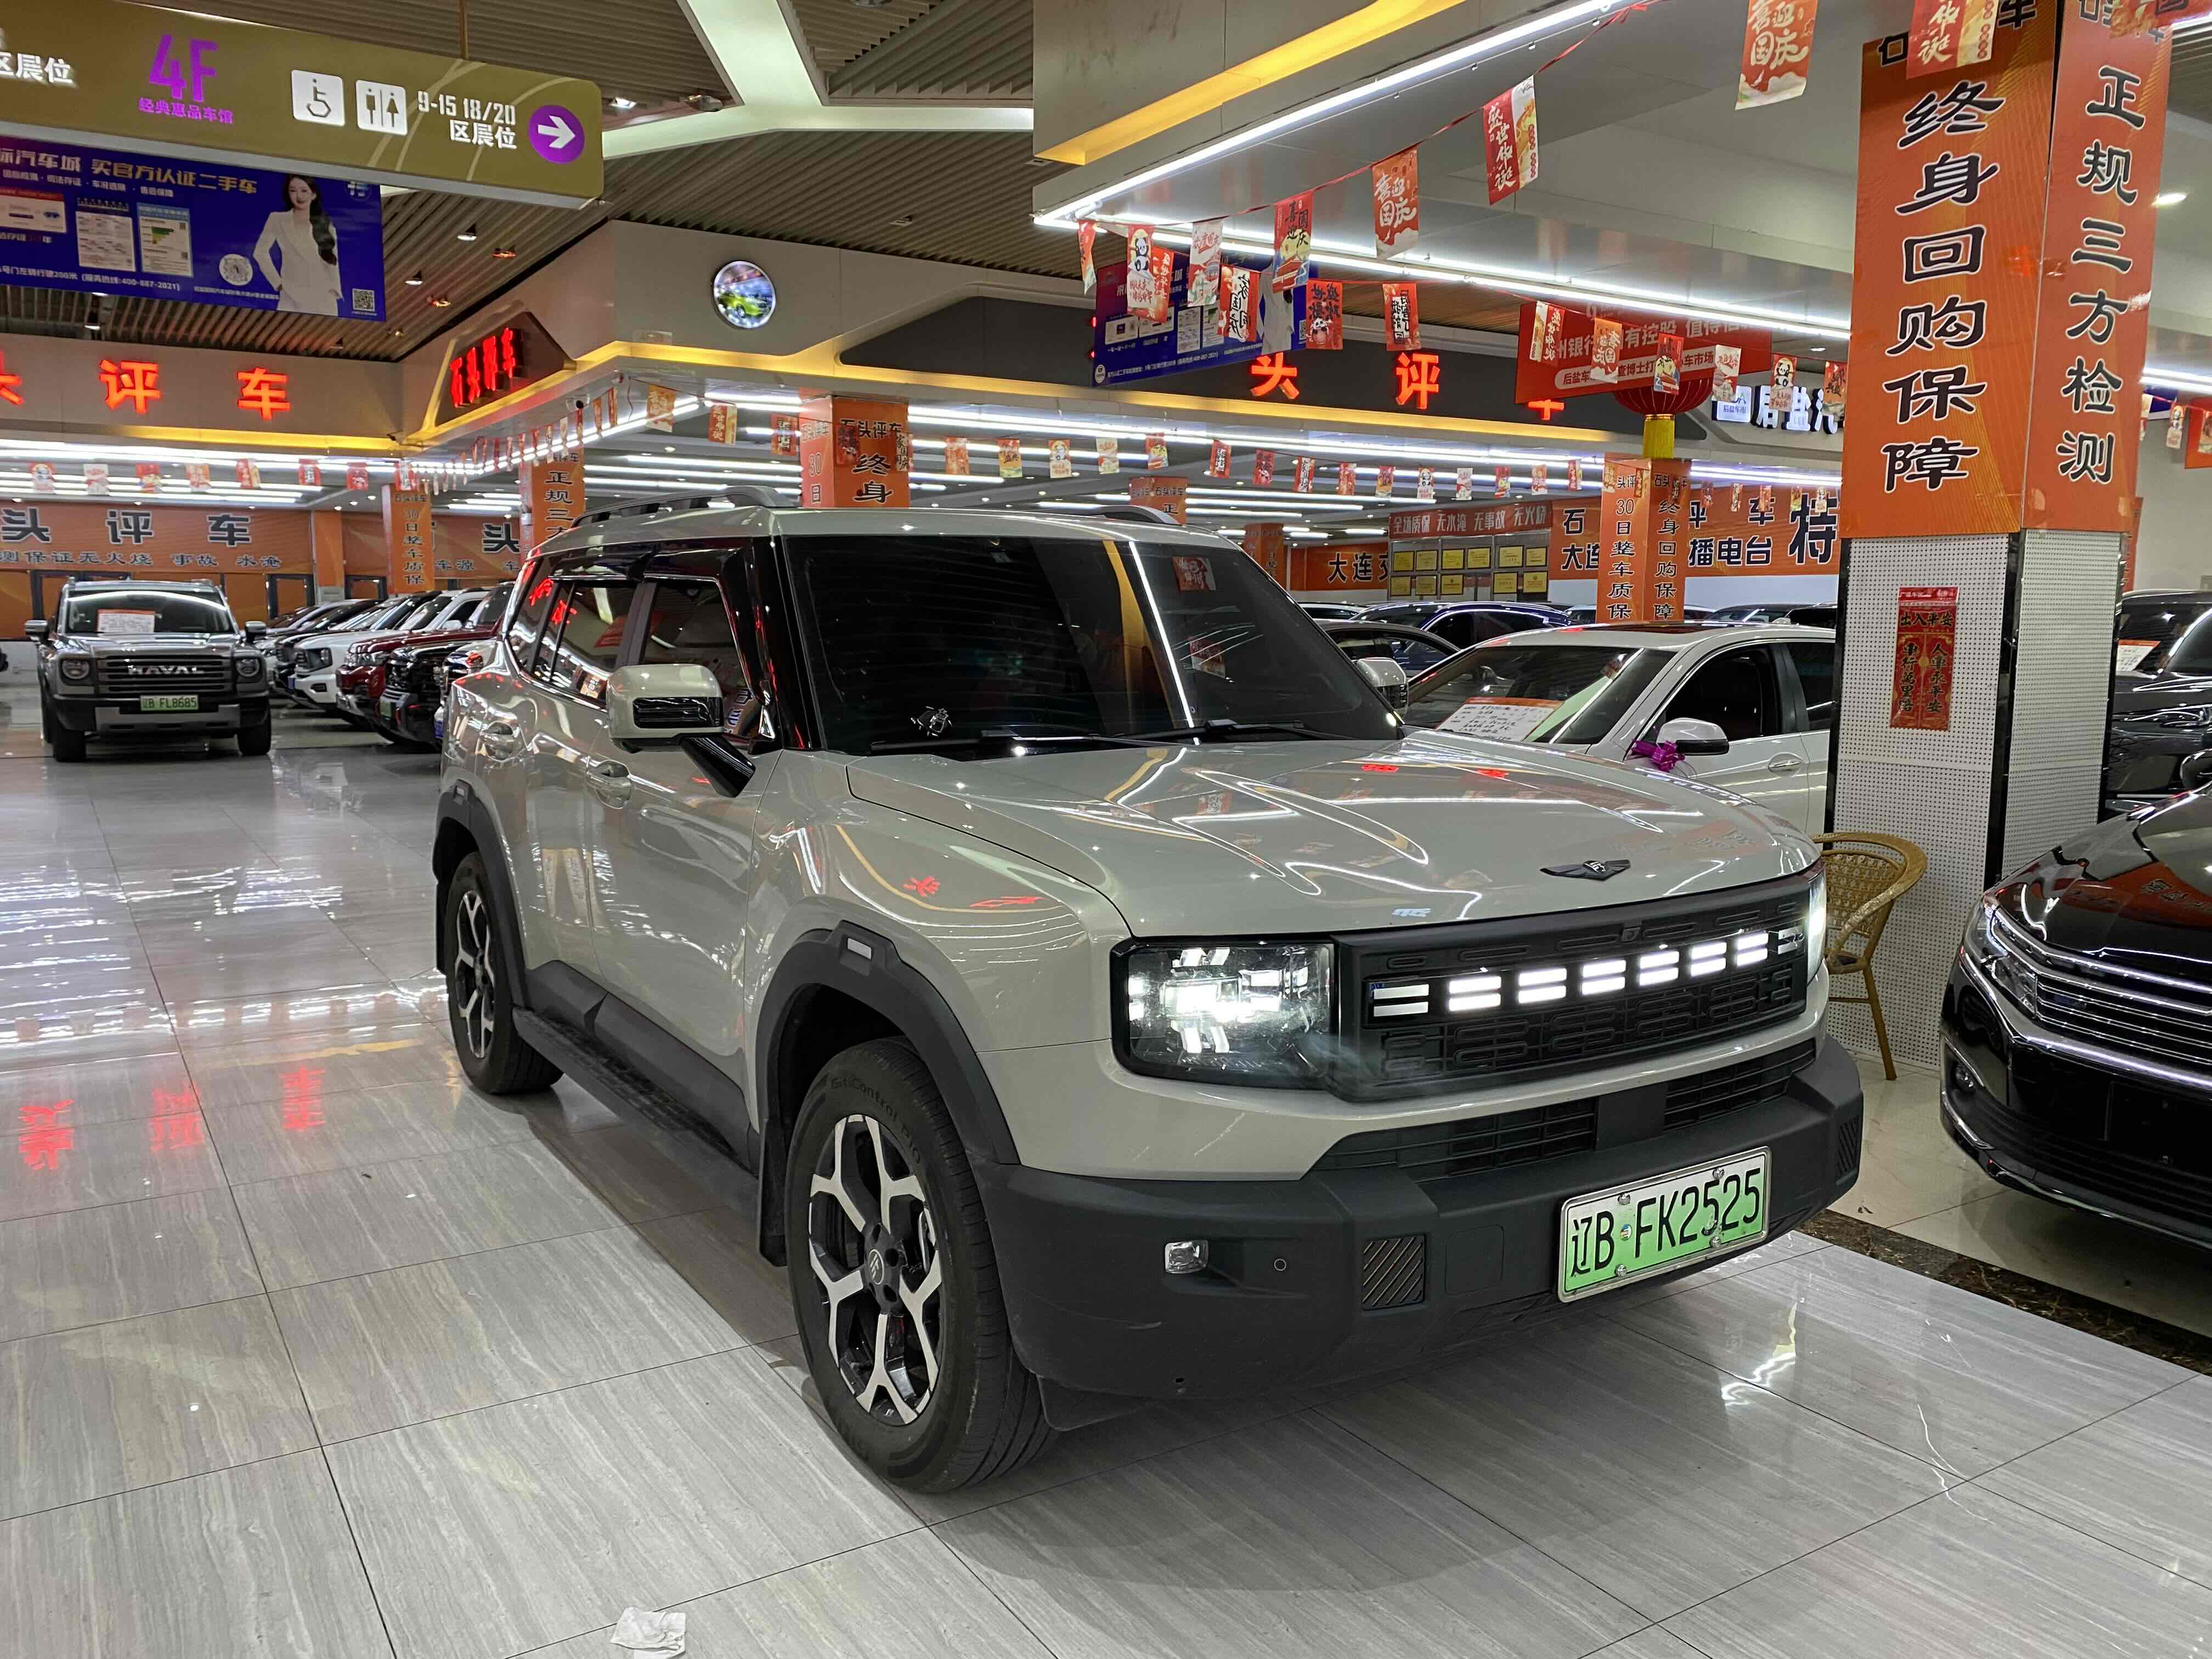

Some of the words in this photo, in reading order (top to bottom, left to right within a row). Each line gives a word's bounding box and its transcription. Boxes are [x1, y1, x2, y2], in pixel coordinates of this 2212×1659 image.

[149, 34, 218, 101] 4F
[417, 91, 457, 117] 9-15
[463, 98, 516, 126] 18/20
[449, 119, 518, 149] 区展位
[1379, 196, 1417, 228] 国庆
[1881, 80, 2006, 493] 终身回购保障
[2056, 65, 2145, 484] 正规三方检测
[851, 453, 894, 504] 终身
[482, 522, 521, 554] 头
[1393, 514, 1431, 534] 全场质保
[1436, 513, 1466, 532] 无水淹
[1474, 509, 1505, 531] 无事故
[1514, 504, 1547, 527] 无火烧
[1788, 493, 1838, 565] 特
[171, 552, 218, 566] 事故
[236, 554, 282, 567] 水淹
[1607, 499, 1636, 620] 30日整车质保
[1654, 500, 1681, 619] 终身回购保障
[1899, 611, 1954, 627] 出入平安
[127, 664, 204, 675] HAVAL
[1571, 1210, 1615, 1278] 辽B
[1634, 1167, 1762, 1259] FK2525
